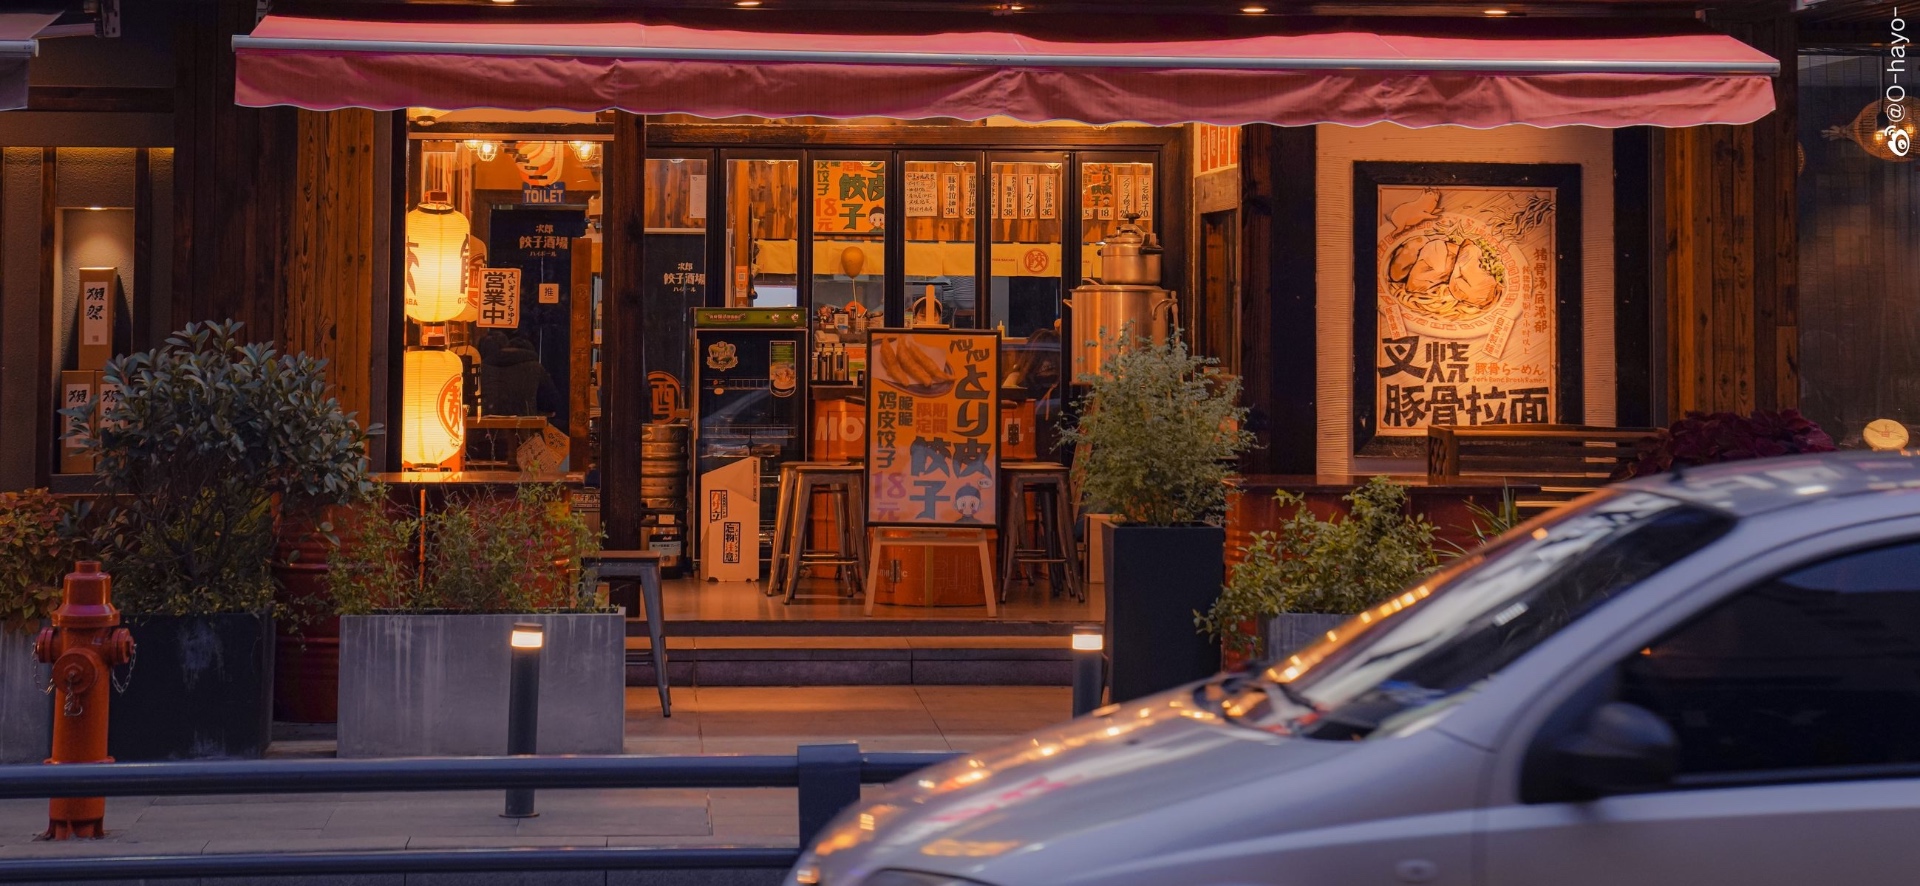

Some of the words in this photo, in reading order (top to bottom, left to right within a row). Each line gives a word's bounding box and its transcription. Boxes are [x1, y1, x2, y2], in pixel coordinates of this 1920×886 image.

[524, 189, 564, 203] TOILET
[814, 197, 837, 217] 18
[838, 172, 867, 231] 餃子
[519, 235, 568, 250] 餃子酒場
[535, 224, 554, 234] 次郎
[482, 271, 507, 325] 営業中
[507, 272, 516, 325] えいぎょうちゅう
[544, 287, 554, 297] 推
[1377, 336, 1470, 383] 叉烧
[1474, 362, 1545, 376] 豚骨らーめん
[1383, 384, 1550, 428] 豚骨拉面
[815, 416, 865, 442] MO
[876, 391, 897, 469] 鸡皮饺子
[952, 364, 993, 479] とり皮
[873, 470, 907, 499] 18
[909, 435, 951, 521] 餃子
[877, 501, 900, 521] 元
